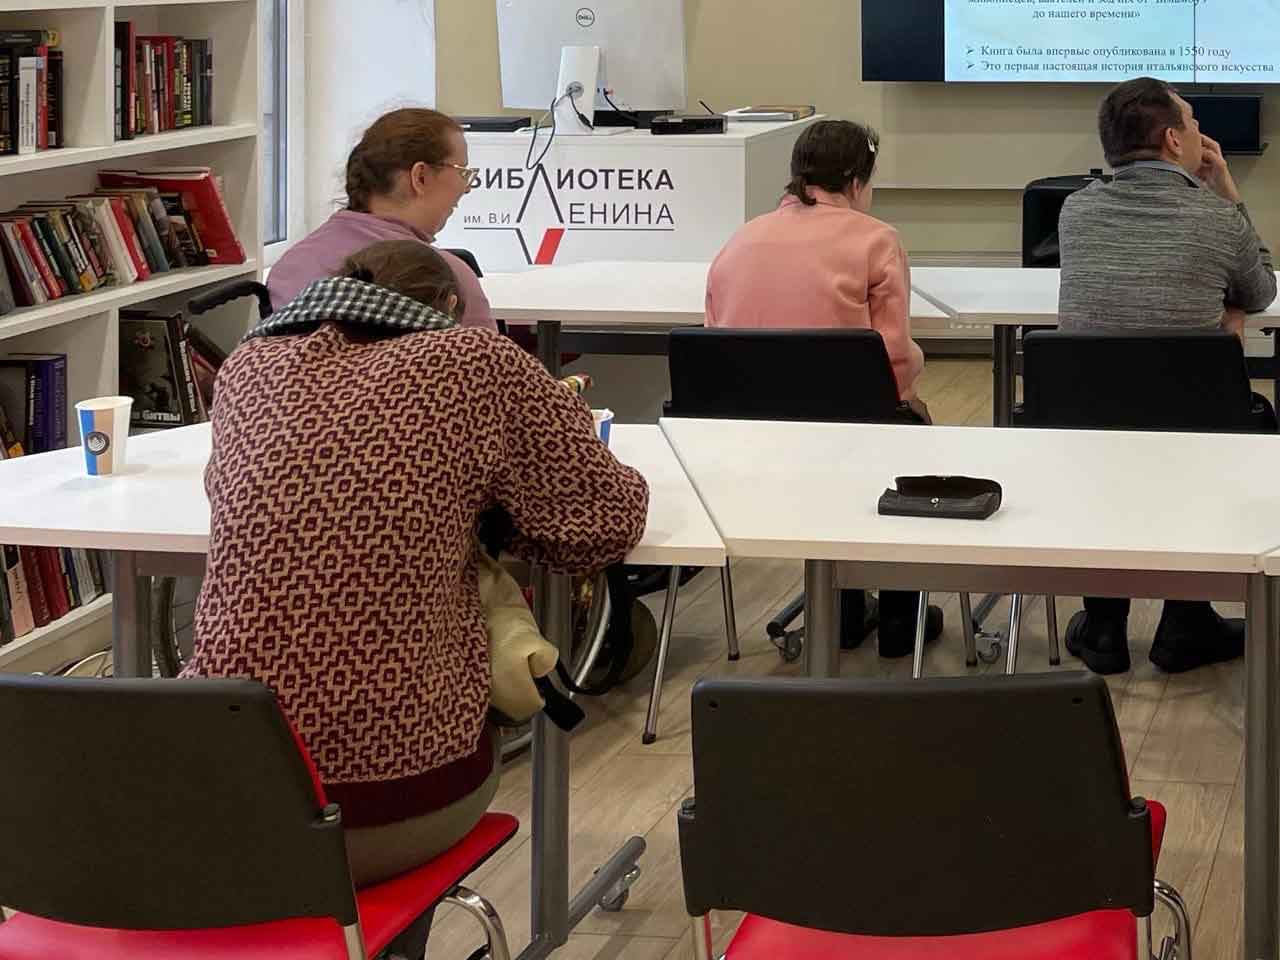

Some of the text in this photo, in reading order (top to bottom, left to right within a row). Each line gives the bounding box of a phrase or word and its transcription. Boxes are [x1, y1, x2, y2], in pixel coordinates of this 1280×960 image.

[1032, 10, 1141, 21] до нашего времени»
[980, 45, 1232, 59] Книга была впервые опубликована в 1550 году
[980, 61, 1274, 75] Это первая настоящая история итальянского искусства
